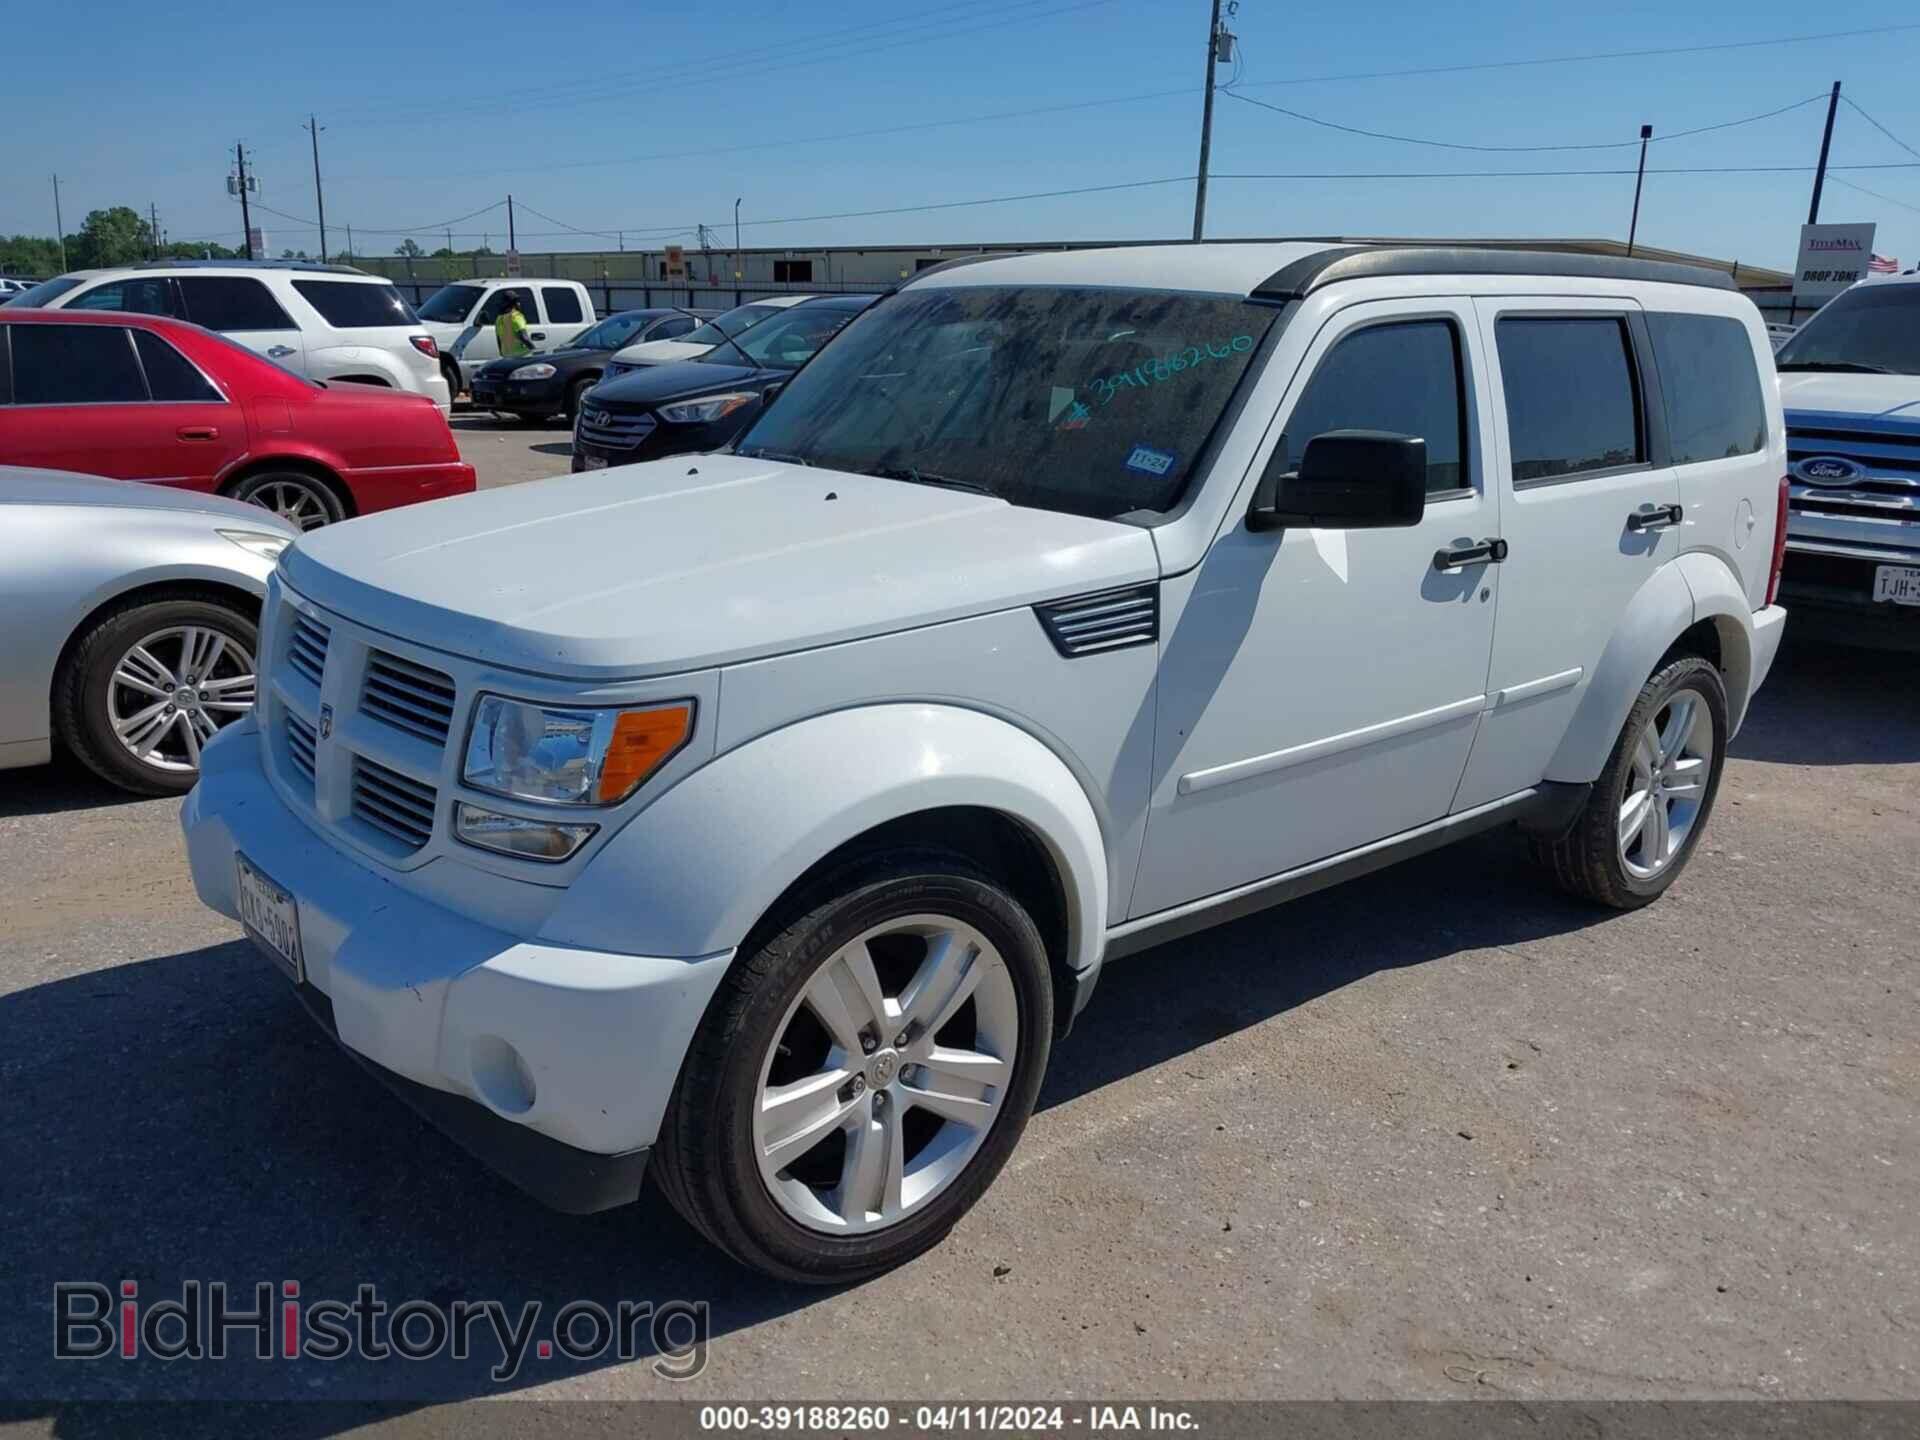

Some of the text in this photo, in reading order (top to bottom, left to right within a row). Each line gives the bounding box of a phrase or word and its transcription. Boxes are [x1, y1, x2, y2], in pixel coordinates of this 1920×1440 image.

[1803, 270, 1860, 282] DROP ZONE
[1810, 463, 1845, 478] Ford
